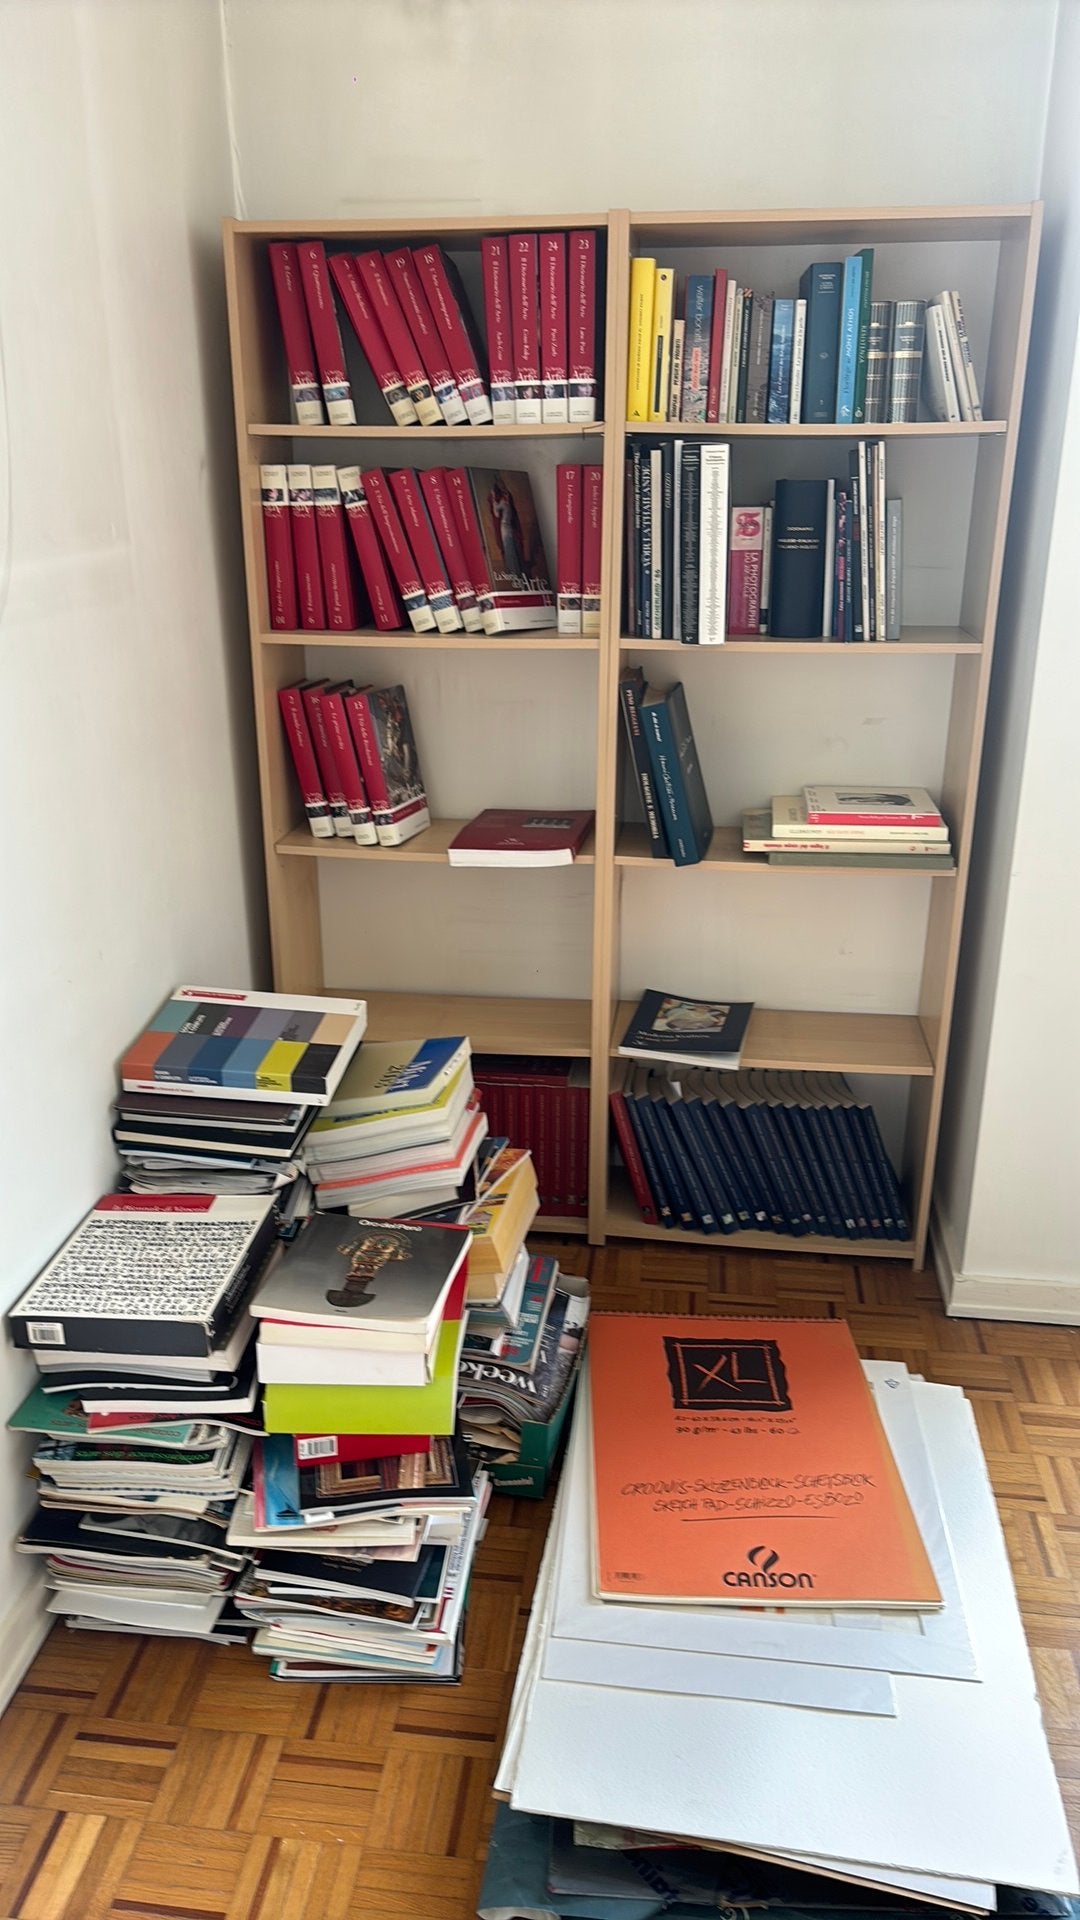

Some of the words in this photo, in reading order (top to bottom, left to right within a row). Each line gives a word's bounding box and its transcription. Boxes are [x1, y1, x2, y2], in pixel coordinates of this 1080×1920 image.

[751, 552, 758, 562] LA
[748, 564, 758, 628] PHOTOGRAPHIE
[692, 1350, 768, 1392] XL
[652, 1498, 697, 1513] SKETCH
[722, 1571, 814, 1588] CANSON
